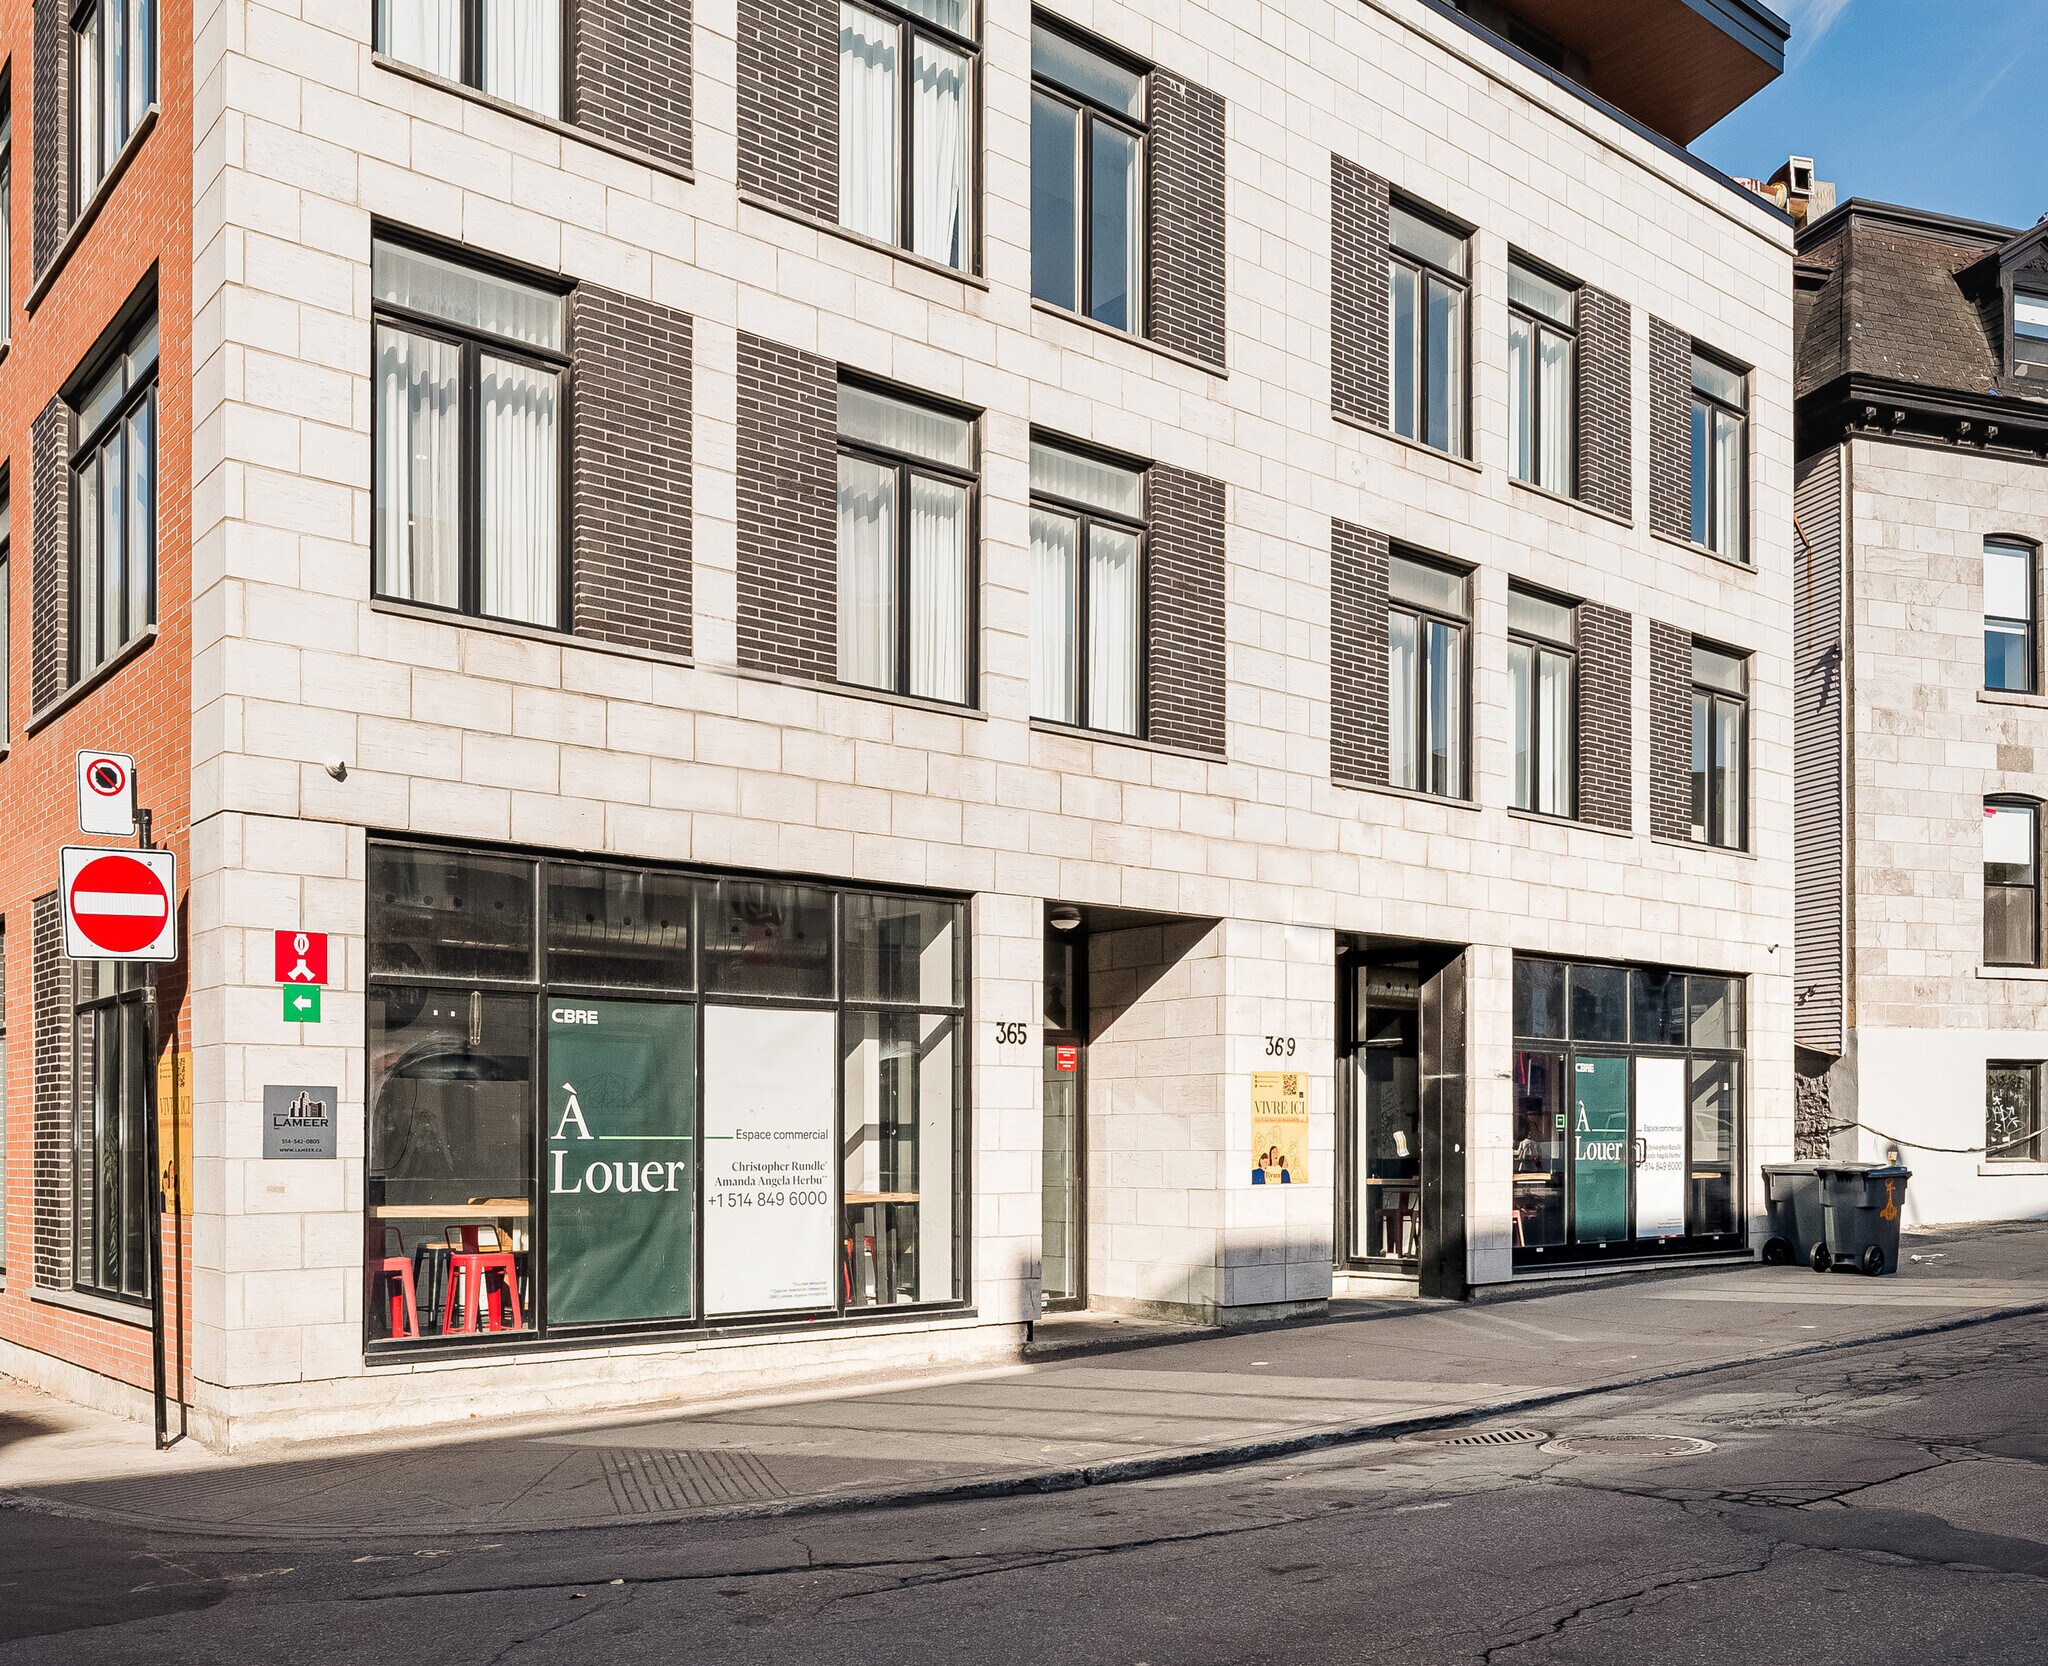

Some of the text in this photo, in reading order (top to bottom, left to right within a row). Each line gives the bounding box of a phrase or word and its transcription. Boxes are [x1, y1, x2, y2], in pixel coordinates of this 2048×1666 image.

[551, 1009, 599, 1024] CBRE
[995, 1022, 1027, 1044] 365
[1265, 1036, 1296, 1056] 369
[1575, 1063, 1595, 1073] CBRE
[550, 1082, 595, 1140] À
[1255, 1101, 1305, 1114] VIVRE ICI
[273, 1117, 329, 1127] LAMEER
[1575, 1100, 1591, 1132] À
[736, 1129, 829, 1142] Espace commercial
[1575, 1136, 1623, 1161] Louer
[550, 1150, 686, 1194] Louer
[731, 1161, 790, 1173] Christopher
[714, 1176, 756, 1187] Amanda
[758, 1175, 791, 1188] Angela
[708, 1191, 828, 1208] +1 514 849 6000
